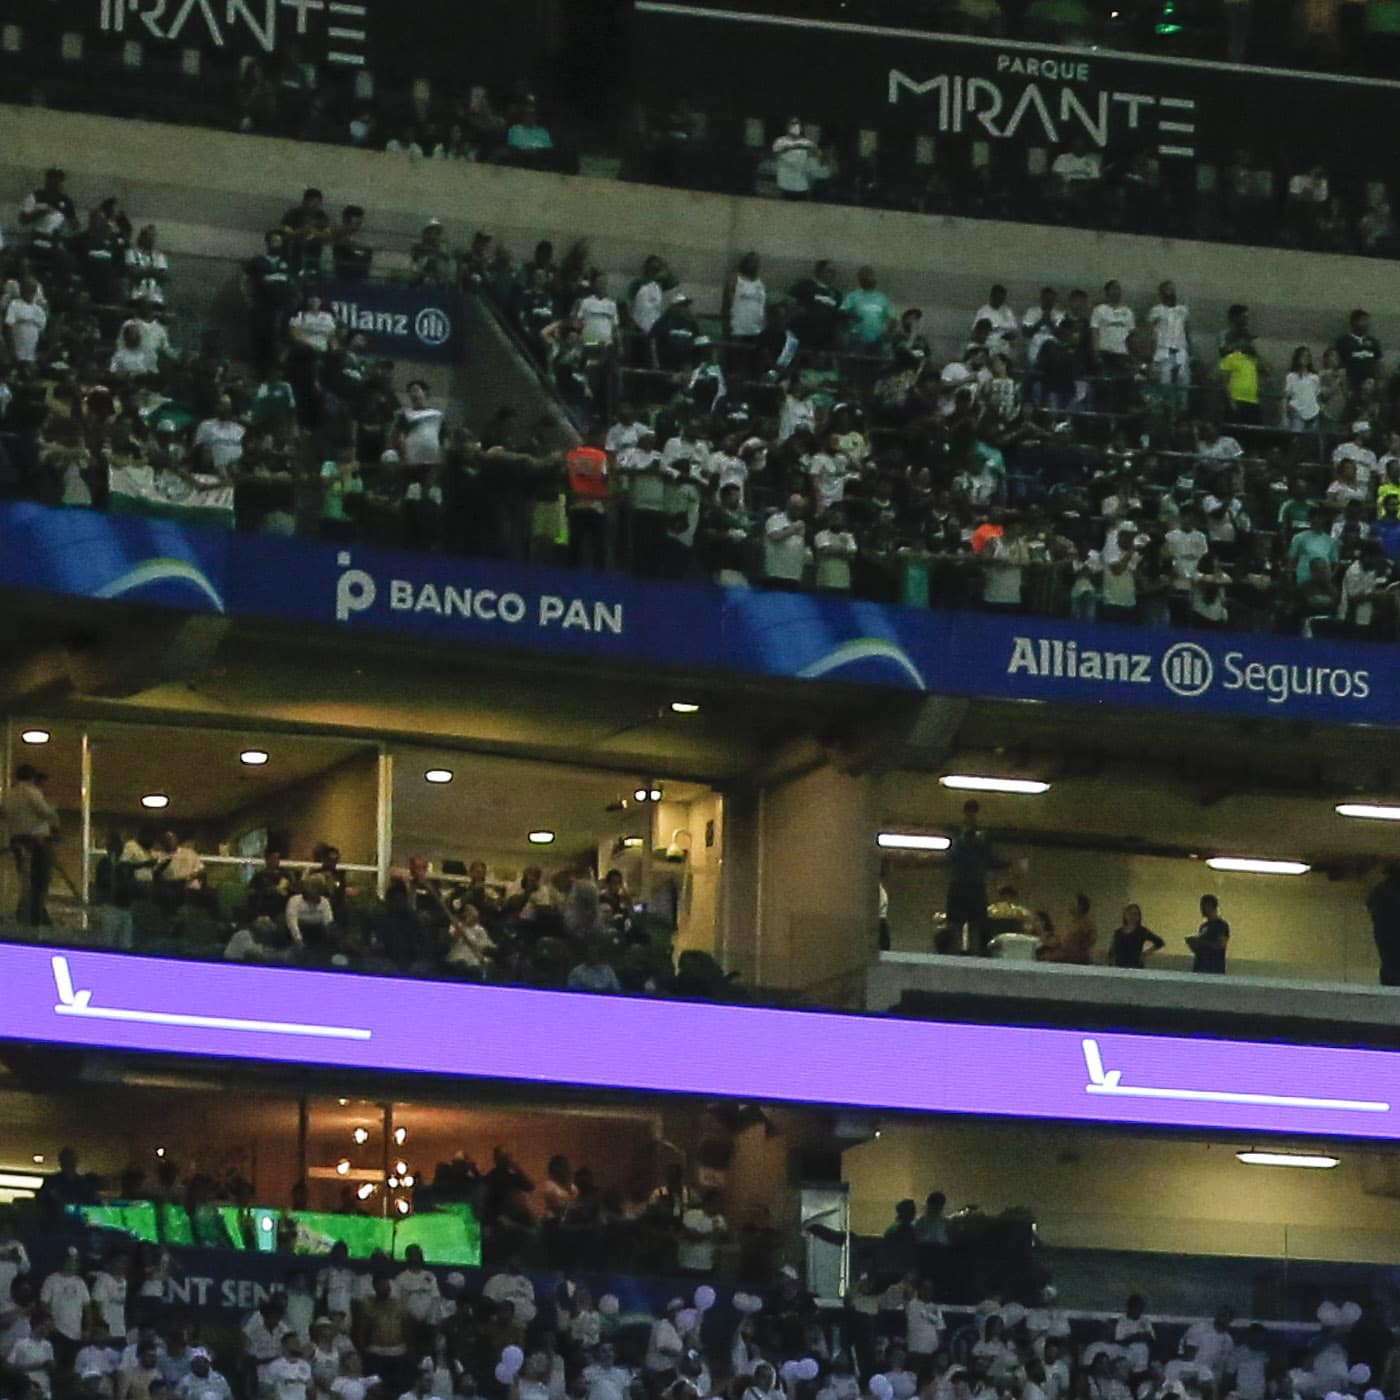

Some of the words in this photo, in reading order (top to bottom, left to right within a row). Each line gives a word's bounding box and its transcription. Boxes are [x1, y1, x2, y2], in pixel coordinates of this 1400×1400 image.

[998, 54, 1090, 82] PARQUE
[887, 67, 1196, 158] MIRANTE
[391, 579, 526, 625] BANCO
[540, 597, 624, 635] PAN
[1007, 636, 1152, 685] Allianz
[1223, 651, 1371, 704] Seguros
